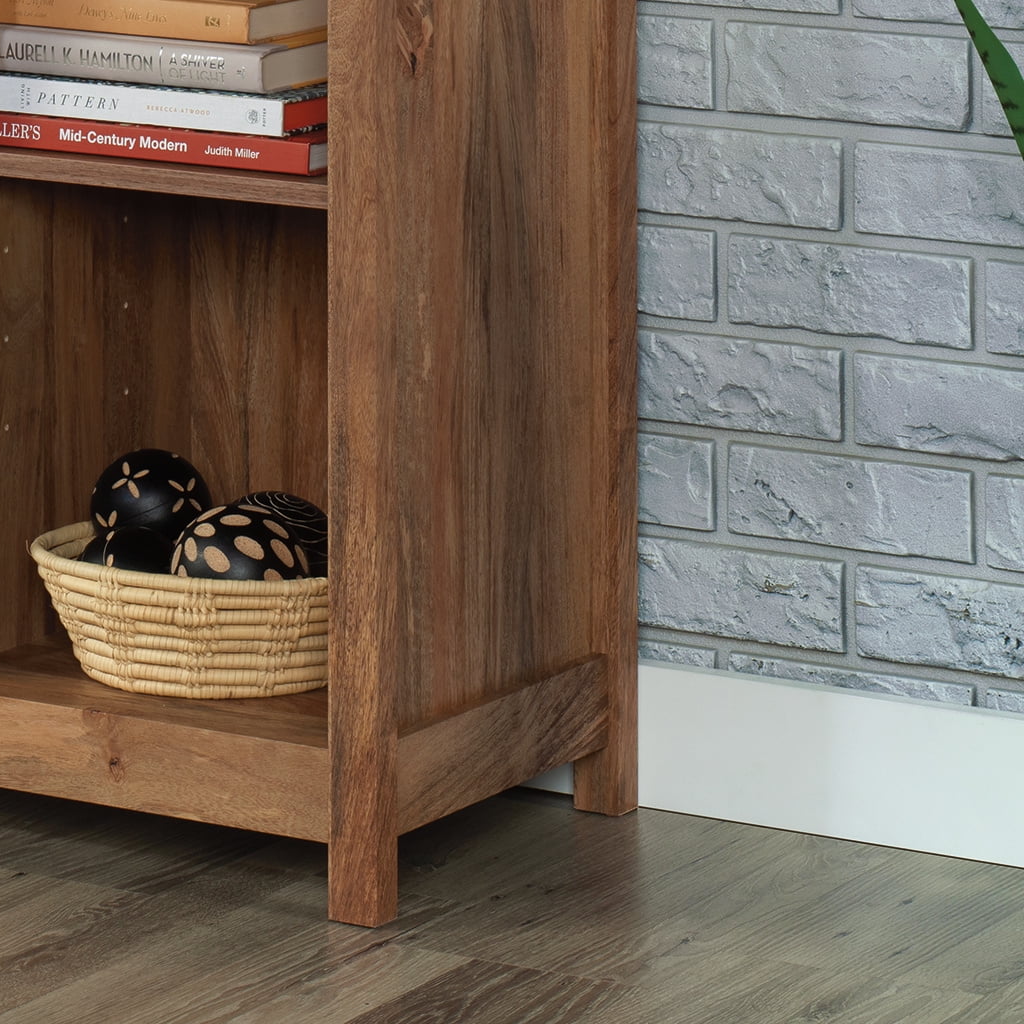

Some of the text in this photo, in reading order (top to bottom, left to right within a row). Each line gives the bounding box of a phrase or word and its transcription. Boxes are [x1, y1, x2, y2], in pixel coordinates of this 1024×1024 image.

[62, 47, 77, 66] K.
[79, 48, 154, 73] HAMILTON
[169, 52, 225, 70] A SHIVER
[37, 91, 120, 110] PATTERN
[146, 104, 211, 116] REBECCA ATWOOD
[59, 128, 136, 149] Mid-Century
[139, 134, 188, 153] Modern
[204, 145, 232, 157] Judith
[235, 148, 260, 159] Miller
